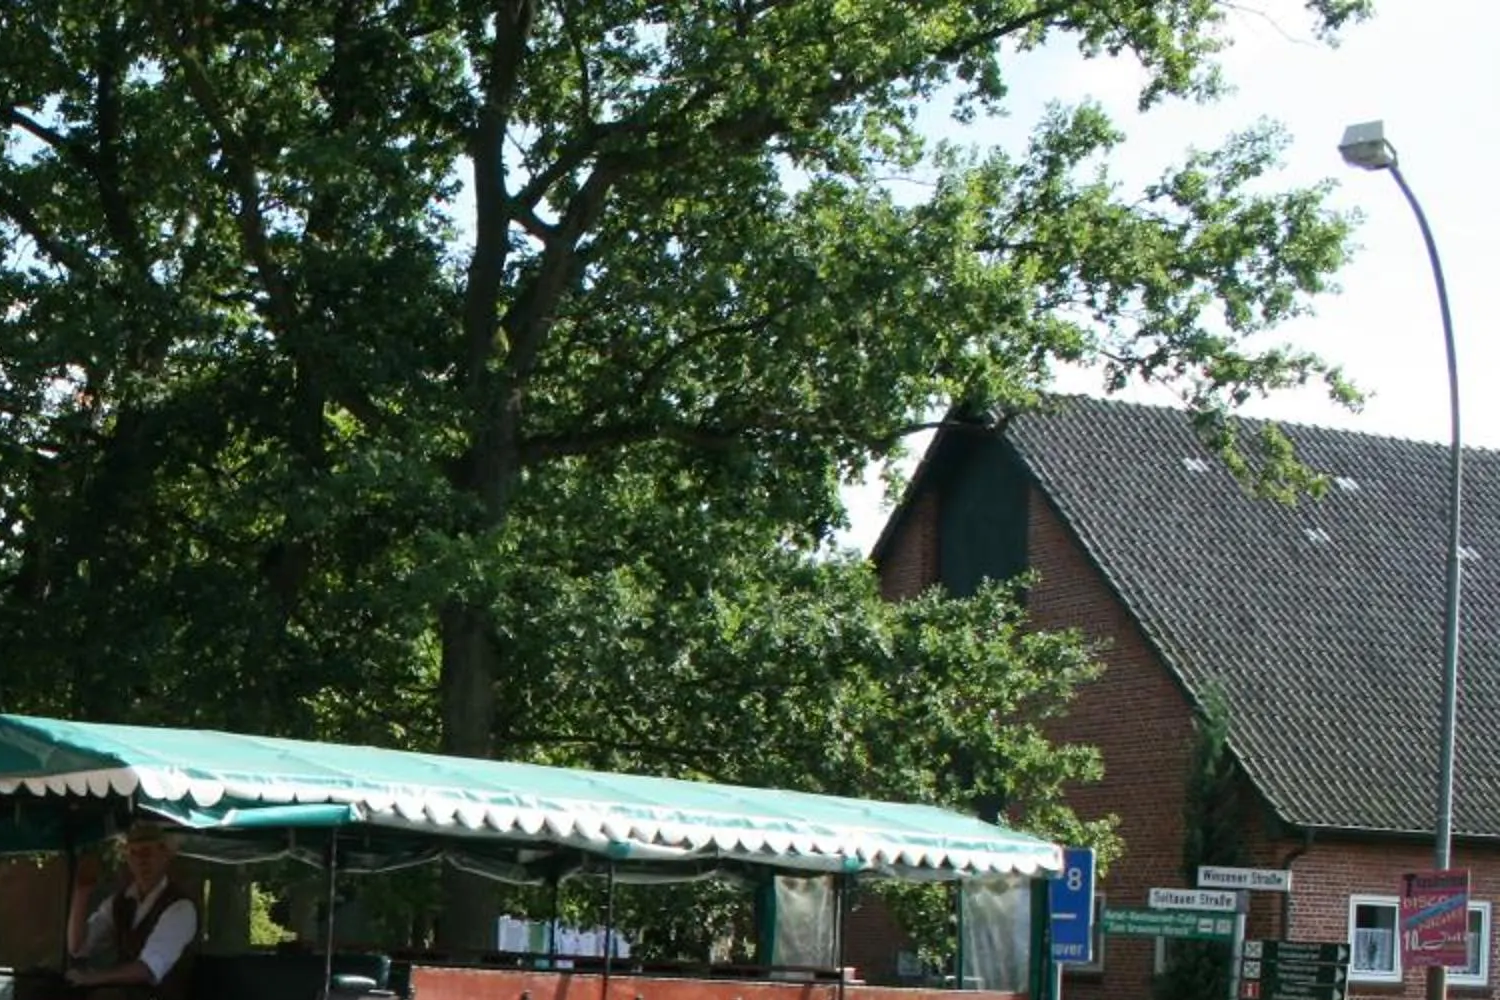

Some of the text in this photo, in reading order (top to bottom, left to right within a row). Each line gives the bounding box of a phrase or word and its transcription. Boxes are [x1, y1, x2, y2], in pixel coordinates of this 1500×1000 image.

[1250, 871, 1283, 886] Straße
[1153, 890, 1233, 906] Soltauer Straße
